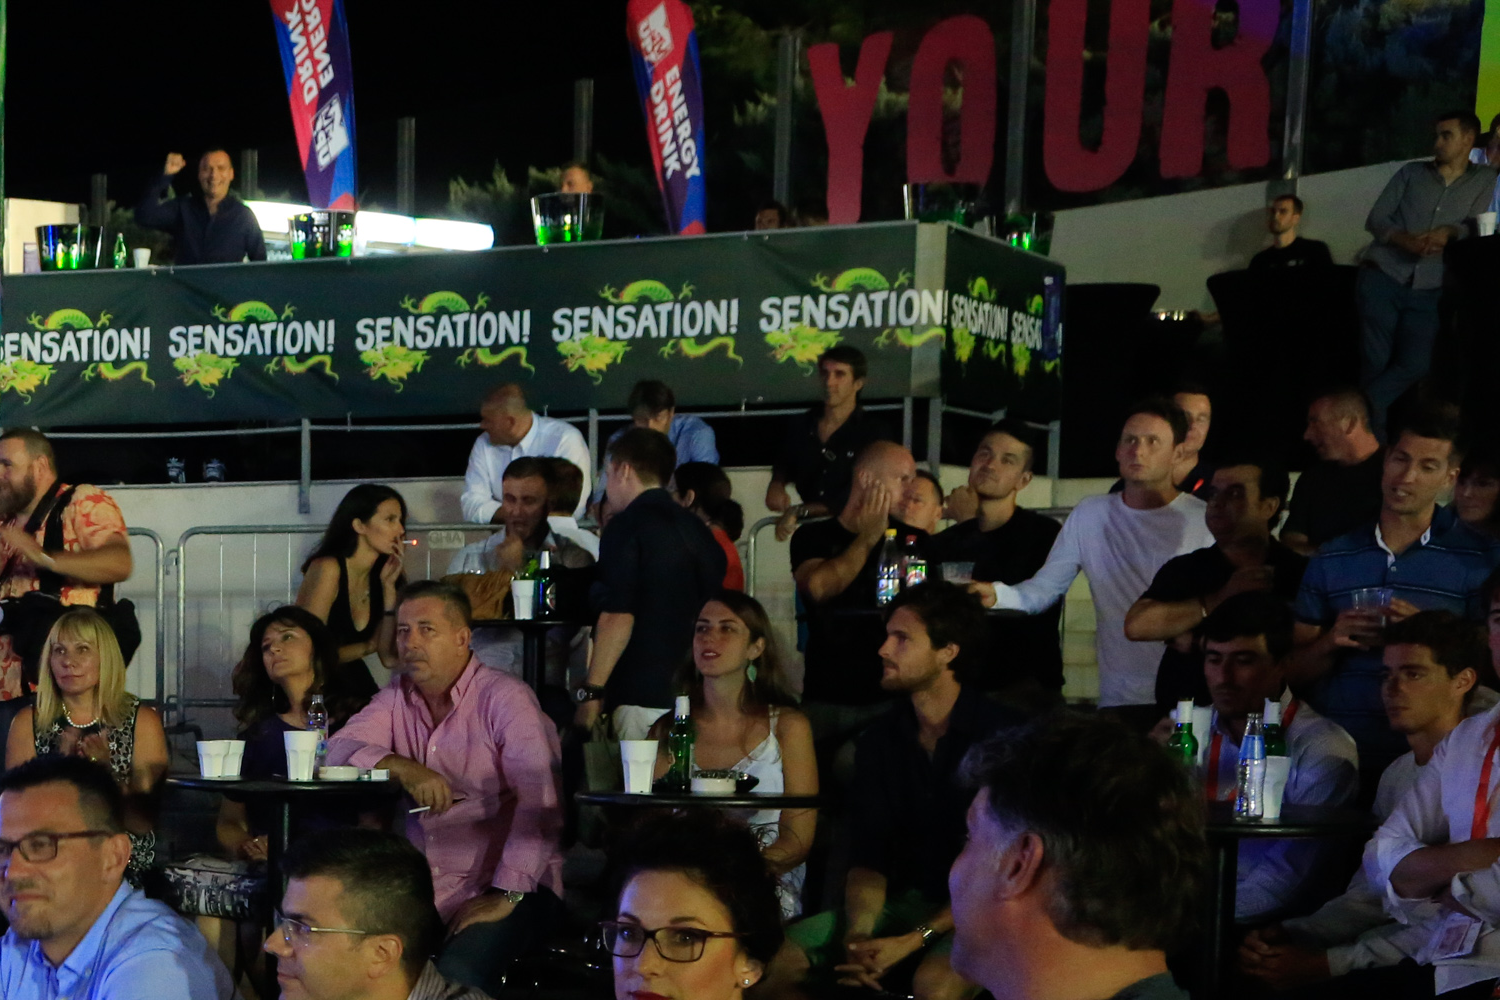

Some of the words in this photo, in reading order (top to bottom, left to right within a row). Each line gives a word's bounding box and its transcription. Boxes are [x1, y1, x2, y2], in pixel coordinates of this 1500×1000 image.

[651, 79, 681, 180] DRINK
[665, 64, 701, 179] ENERGY
[807, 0, 1279, 224] YOUR
[169, 319, 336, 359] SENSATION!
[355, 309, 531, 353] SENSATION!
[551, 299, 739, 342] SENSATION!
[759, 289, 949, 333] SENSATION!
[951, 293, 1008, 341] SENSATION!
